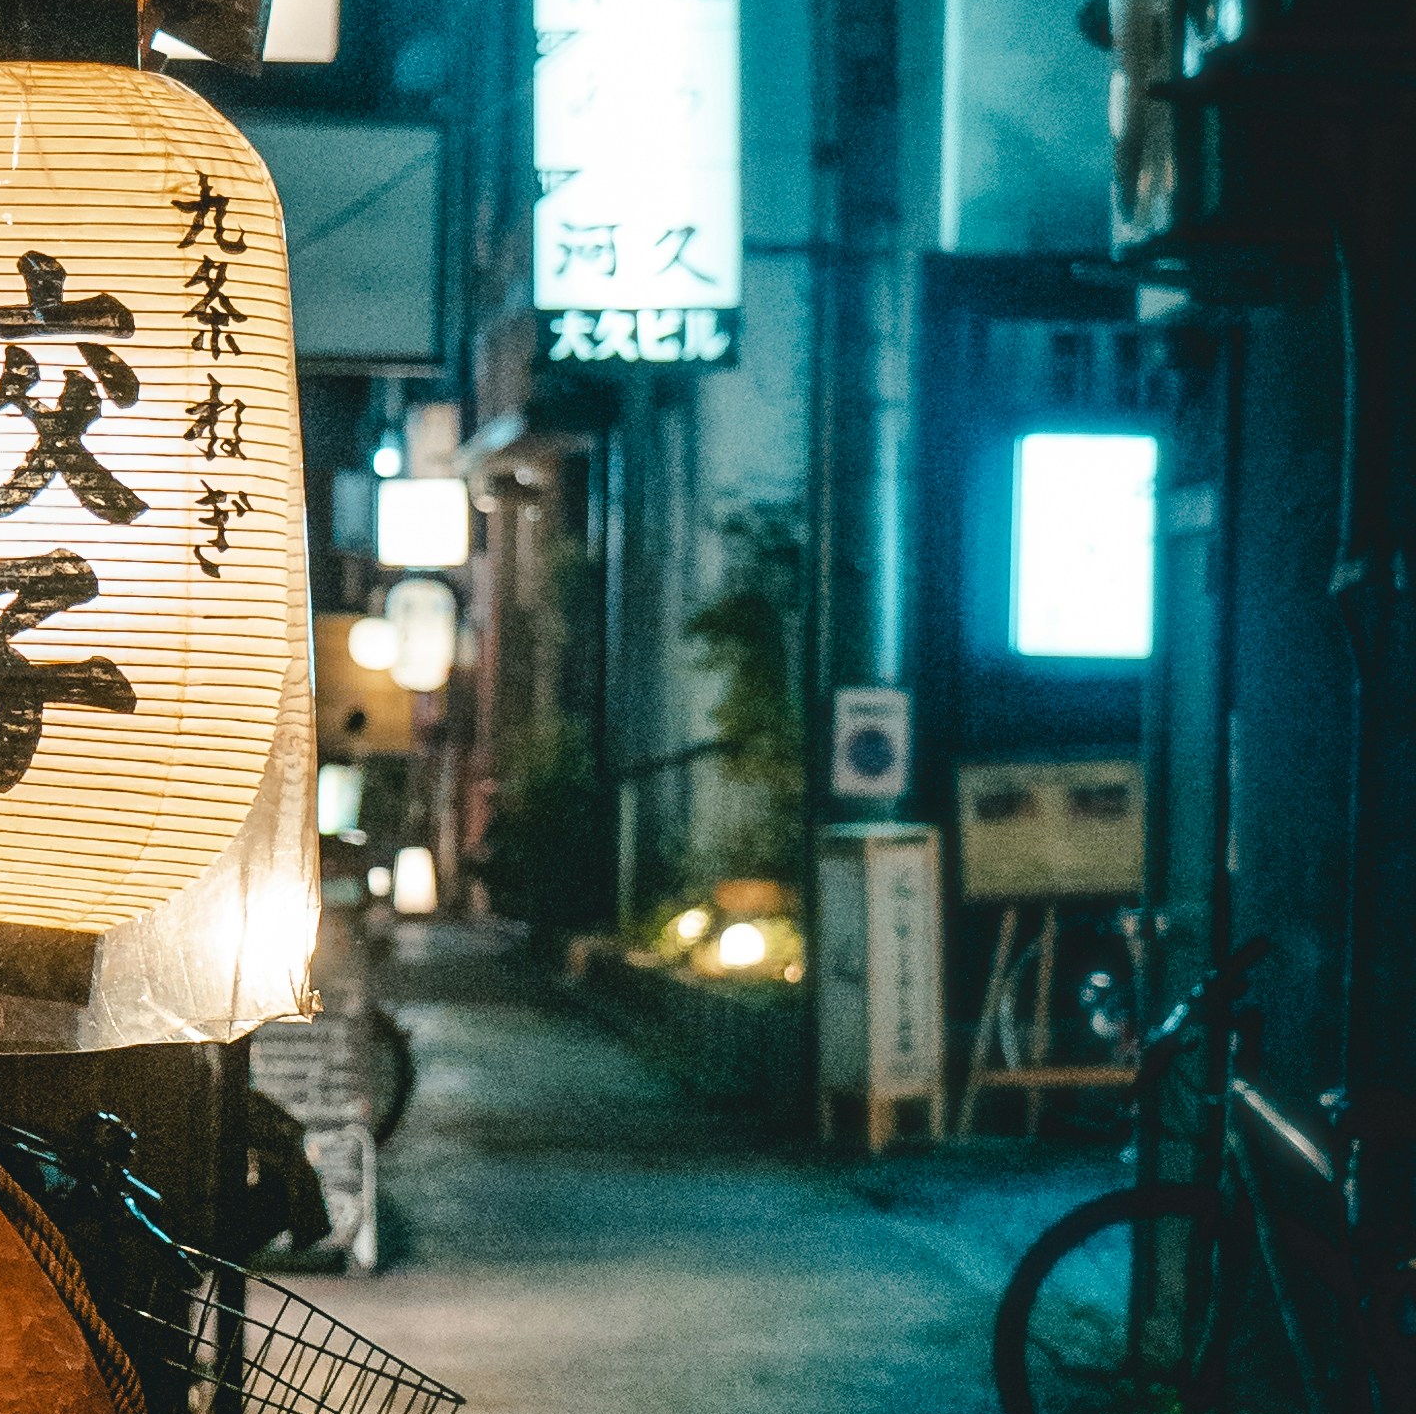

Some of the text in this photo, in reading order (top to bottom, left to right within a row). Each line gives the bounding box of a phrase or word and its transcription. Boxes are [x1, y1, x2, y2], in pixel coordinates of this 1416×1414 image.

[172, 170, 248, 578] 九条ねぎ
[548, 307, 732, 362] 大久ビル
